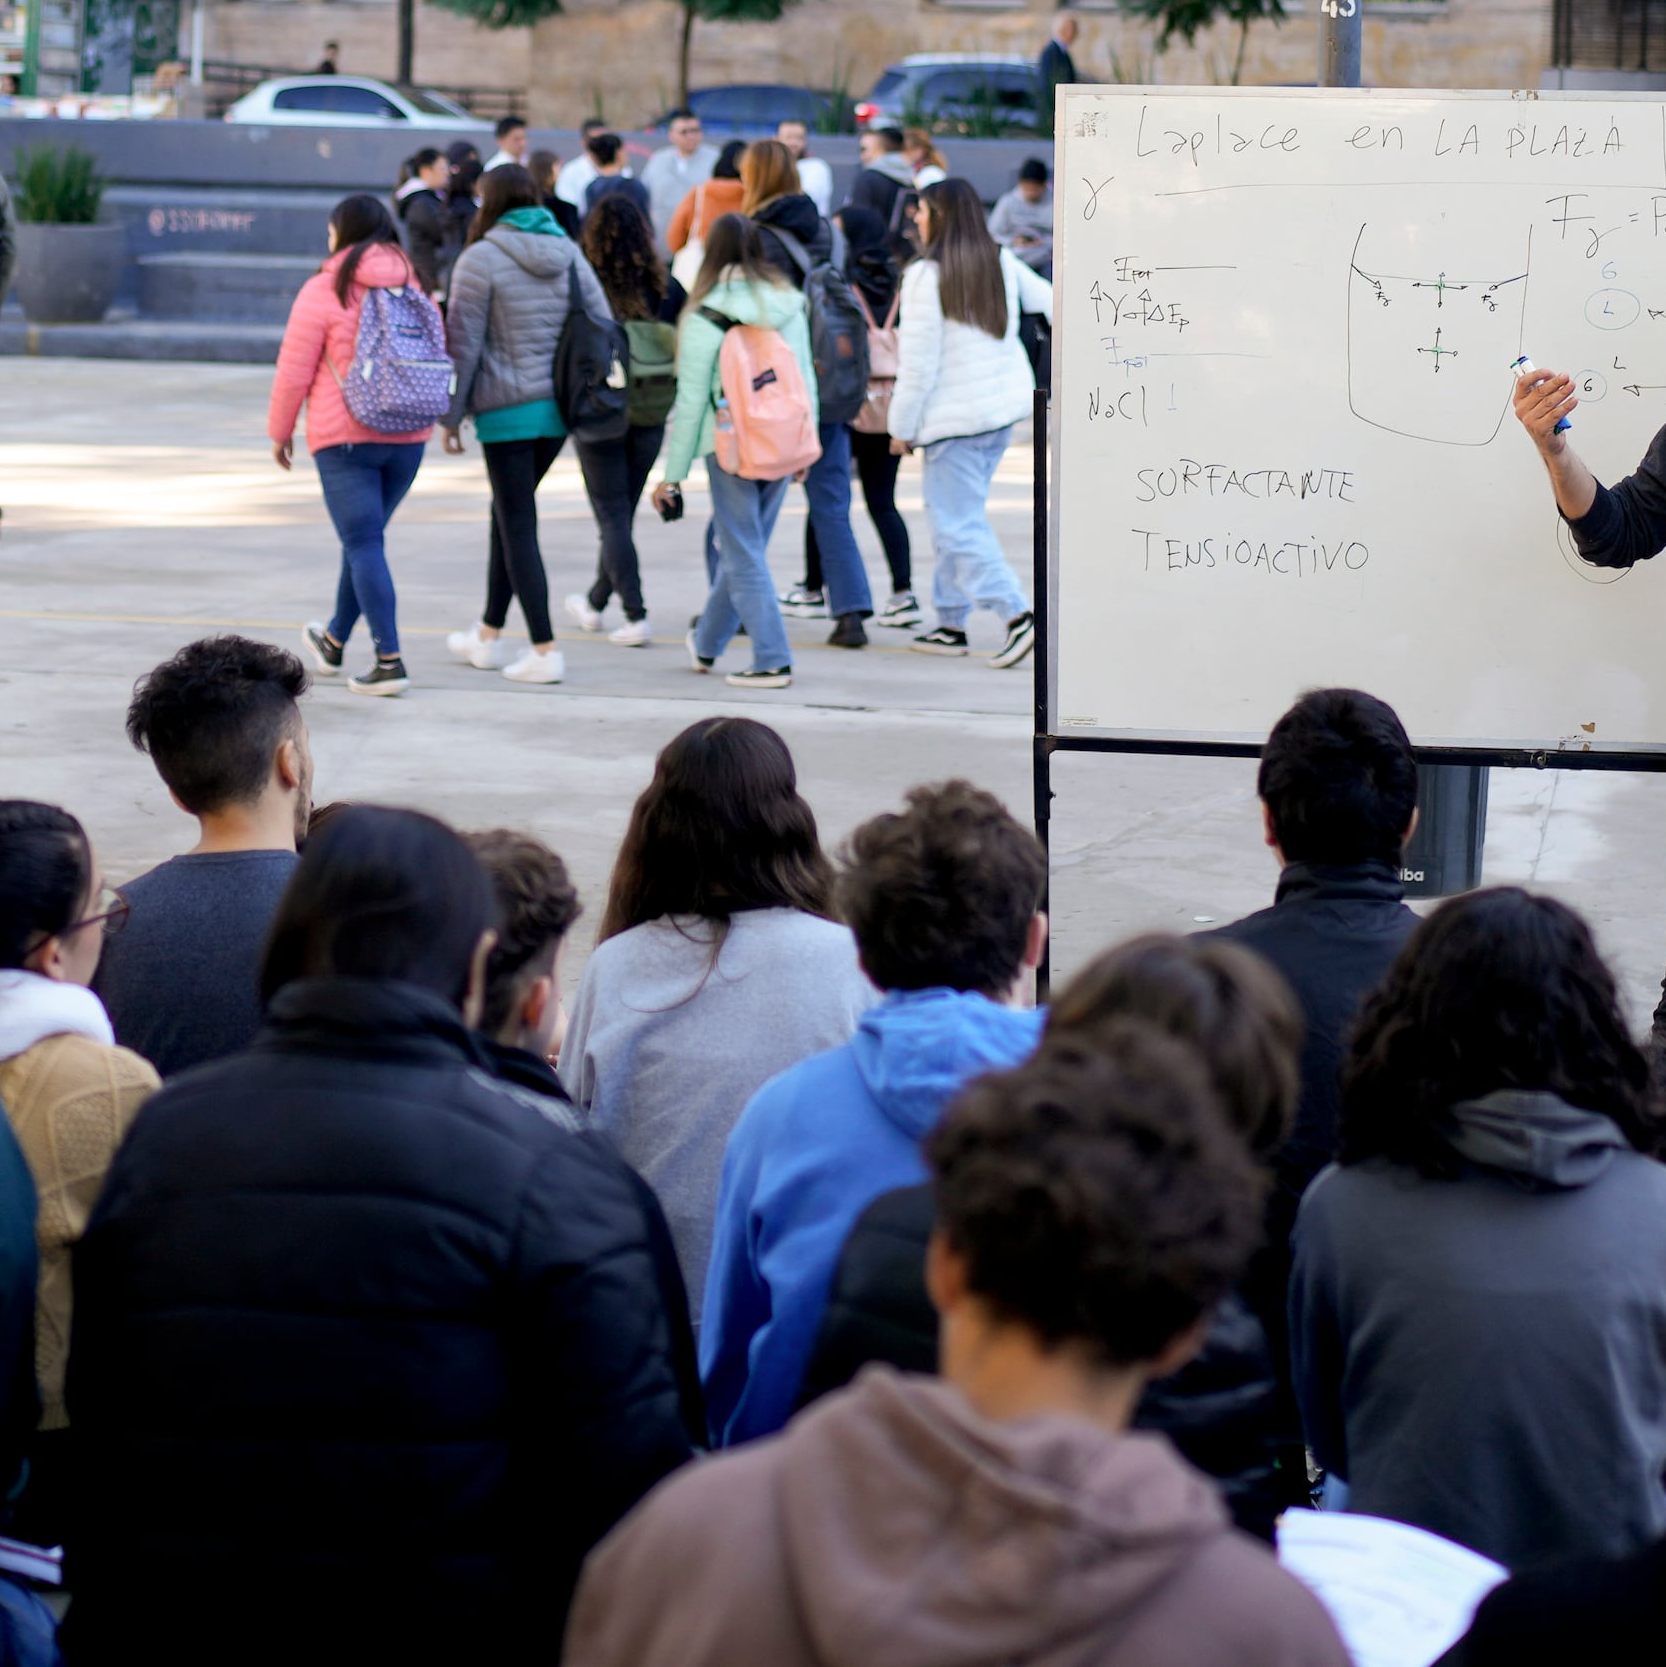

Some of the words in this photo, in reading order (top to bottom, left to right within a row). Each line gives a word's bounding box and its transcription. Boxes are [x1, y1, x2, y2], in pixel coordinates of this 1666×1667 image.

[1136, 105, 1301, 166] Laplace
[1344, 124, 1404, 151] en
[1434, 118, 1479, 156] LA
